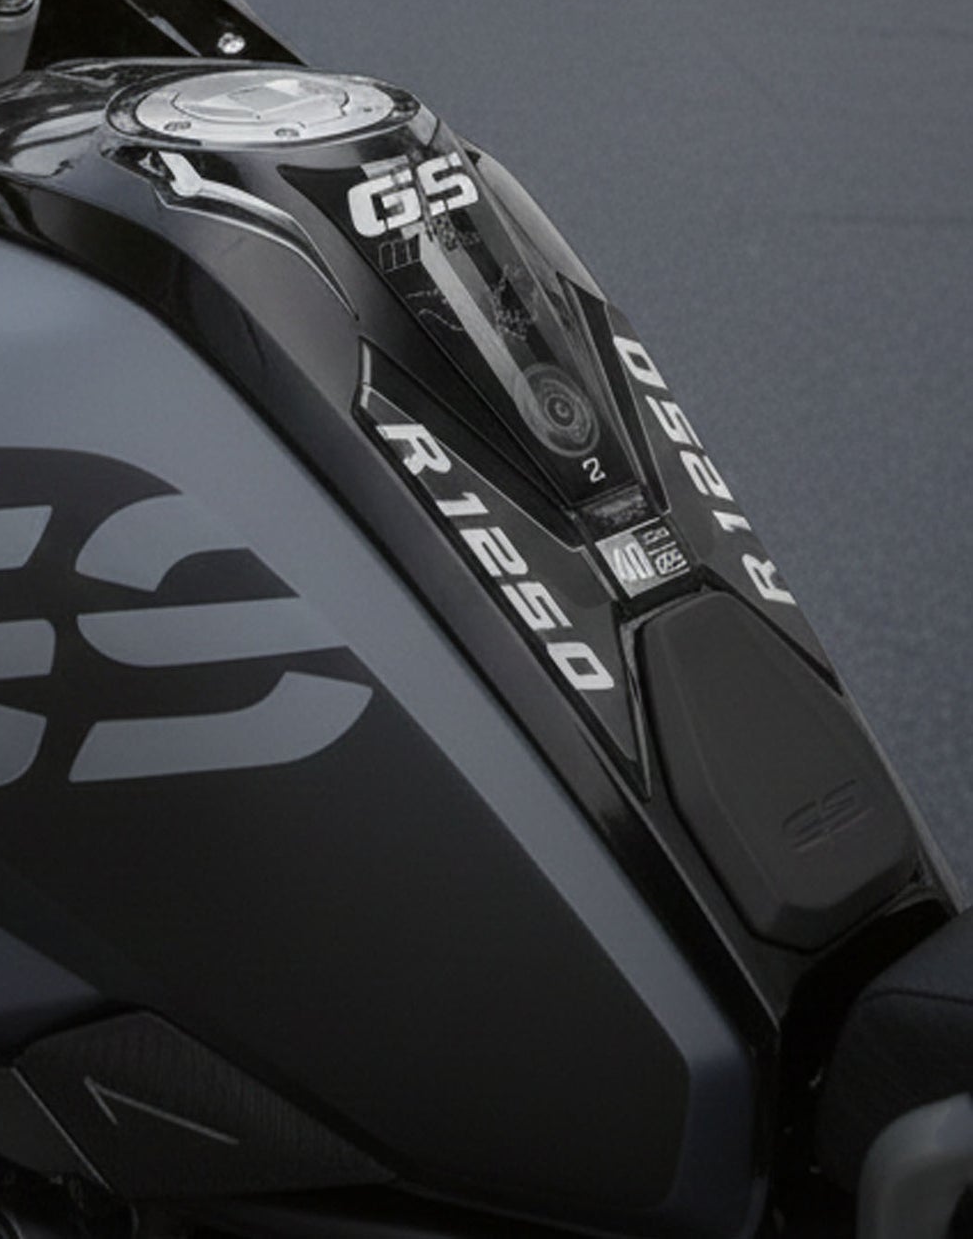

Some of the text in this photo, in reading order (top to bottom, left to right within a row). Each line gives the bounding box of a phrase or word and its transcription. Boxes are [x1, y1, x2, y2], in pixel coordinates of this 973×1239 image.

[348, 152, 478, 237] GS
[376, 424, 615, 691] R 1250
[612, 335, 796, 606] R 1250
